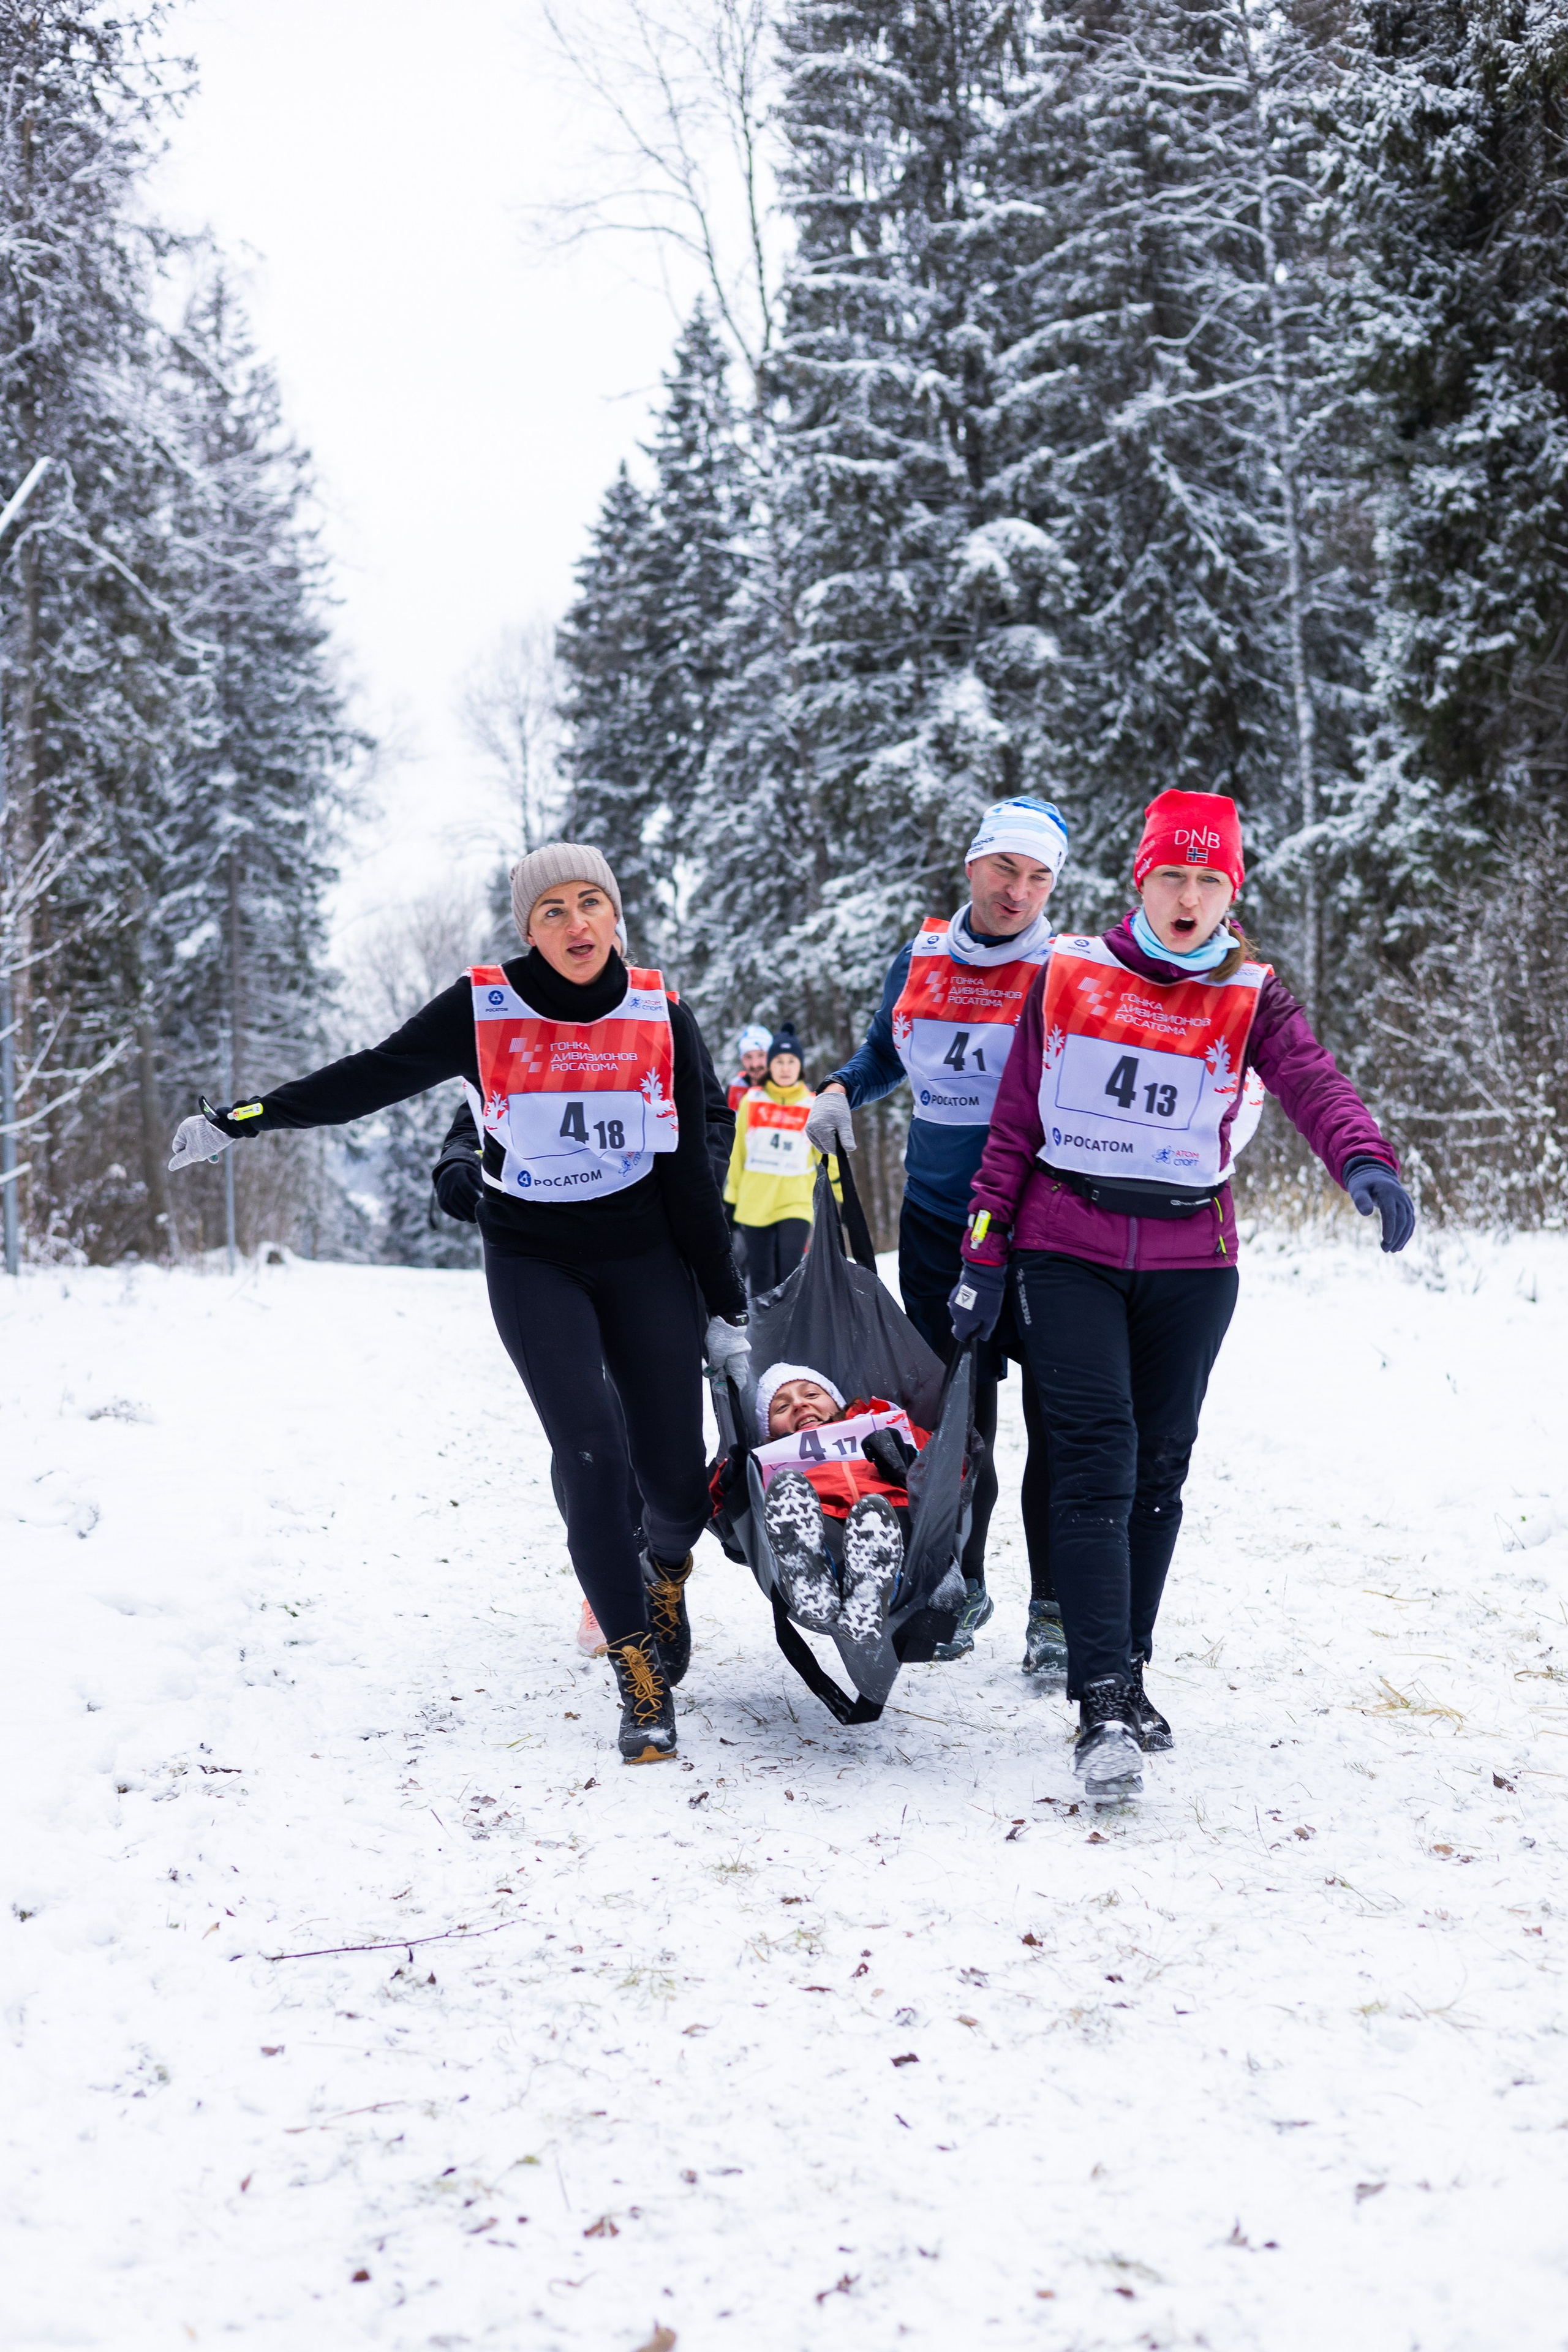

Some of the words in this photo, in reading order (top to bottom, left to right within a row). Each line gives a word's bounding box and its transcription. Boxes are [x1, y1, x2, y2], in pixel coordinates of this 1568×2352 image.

[1174, 825, 1220, 848] DNB
[950, 976, 984, 986] ГОНКА
[948, 995, 1003, 1007] РОСАТОМА
[949, 987, 1023, 999] ДИВИЗИОНОВ
[1120, 993, 1163, 1011] ГОНКА
[1114, 1013, 1187, 1036] РОСАТОМА
[1117, 1005, 1212, 1027] ДИВИЗИОНОВ
[550, 1041, 590, 1051] ГОНКА
[943, 1031, 970, 1071] 4
[973, 1048, 987, 1071] 1
[551, 1052, 638, 1063] ДИВИЗИОНОВ
[551, 1061, 619, 1072] РОСАТОМА
[1105, 1055, 1139, 1109] 4
[1144, 1082, 1178, 1117] 13
[932, 1095, 979, 1106] РОСАТОМ
[560, 1102, 589, 1144] 4
[594, 1120, 625, 1149] 18
[770, 1134, 779, 1148] 4
[1064, 1134, 1133, 1153] РОСАТОМ
[1176, 1150, 1200, 1158] АТОМ
[534, 1169, 602, 1186] РОСАТОМ
[799, 1430, 826, 1461] 4
[832, 1436, 856, 1455] 17
